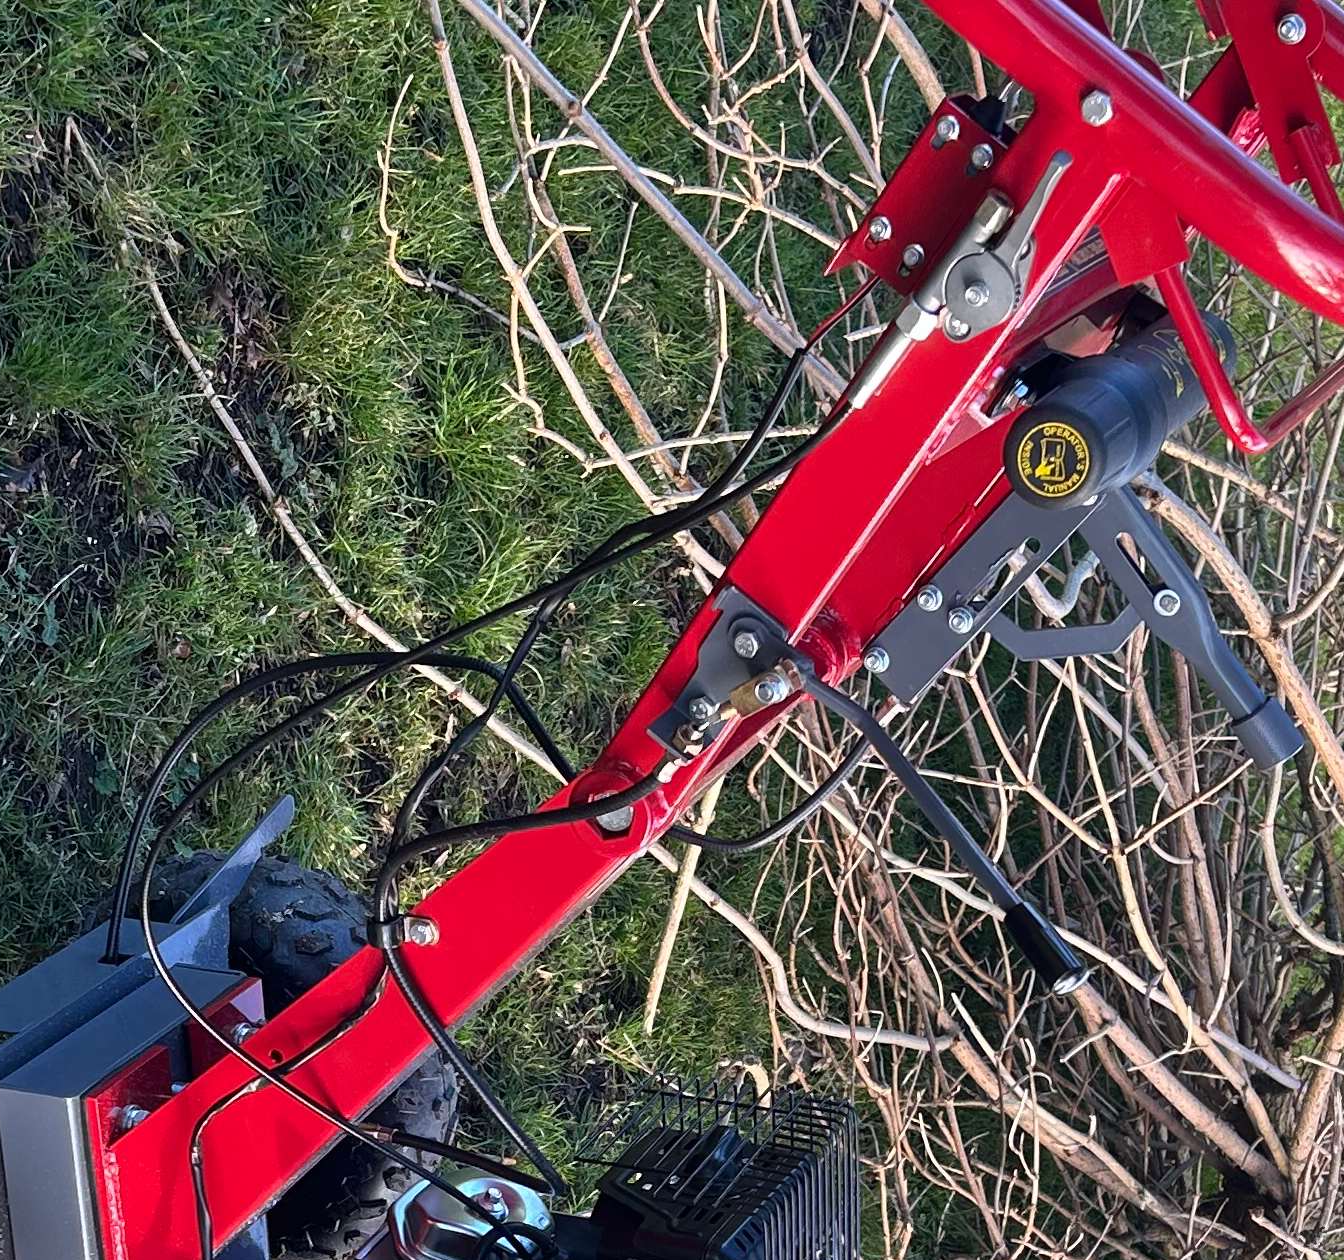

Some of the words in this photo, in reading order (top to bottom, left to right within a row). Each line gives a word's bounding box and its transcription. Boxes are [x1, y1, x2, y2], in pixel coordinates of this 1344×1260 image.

[1021, 440, 1034, 477] INSIDE
[1043, 426, 1085, 471] OPERATOR'S
[1043, 473, 1080, 493] MANUAL
